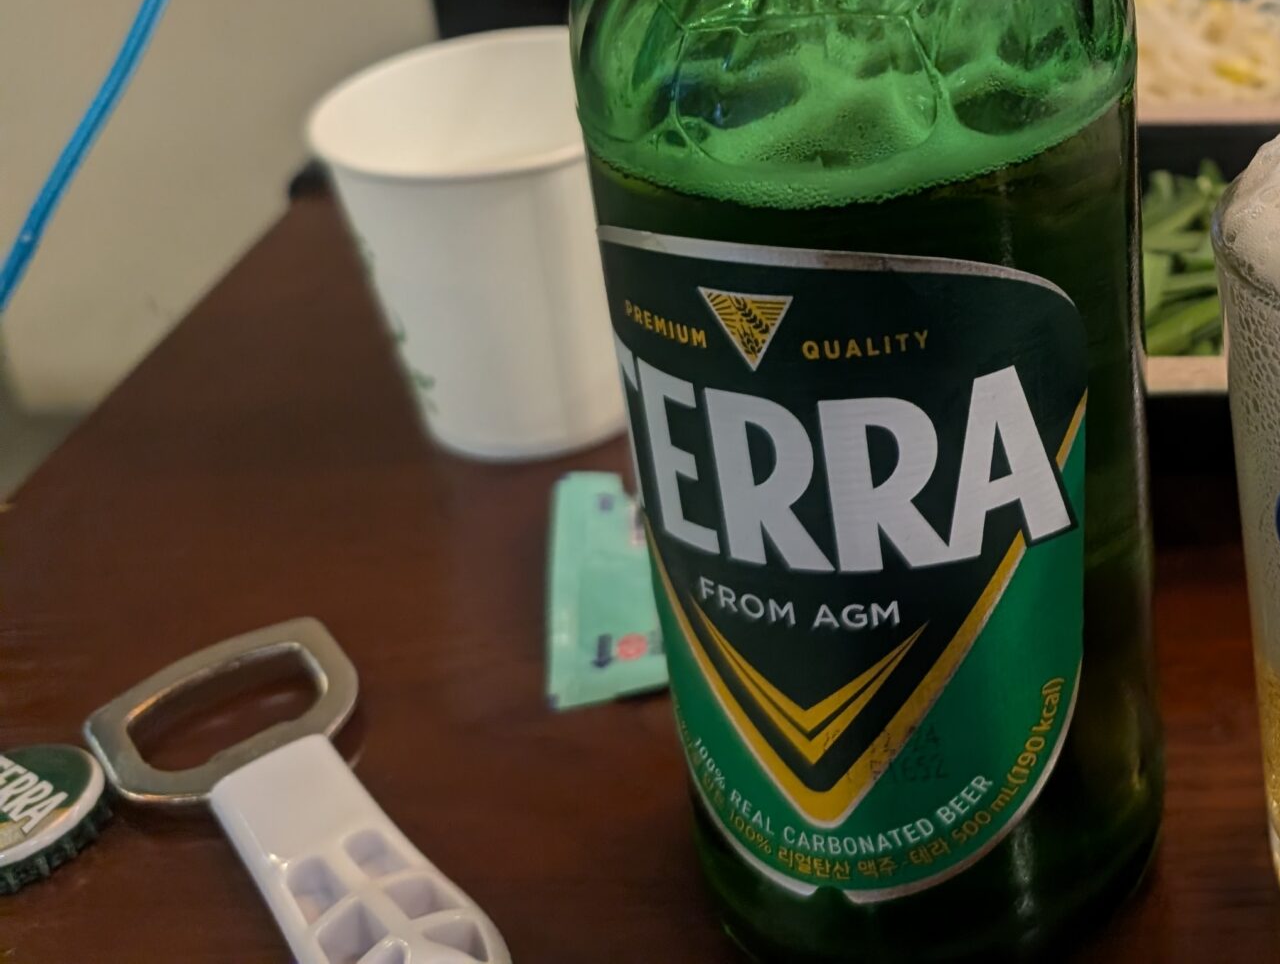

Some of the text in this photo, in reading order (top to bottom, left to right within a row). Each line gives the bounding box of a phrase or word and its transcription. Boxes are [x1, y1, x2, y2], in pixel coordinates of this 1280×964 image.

[623, 299, 928, 361] PREMIUM QUALITY
[698, 577, 901, 629] FROM AGM
[0, 755, 69, 834] ERRA
[694, 737, 727, 790] 100%
[729, 788, 776, 836] REAL
[783, 816, 935, 857] CARBONATED
[935, 774, 994, 825] BEER
[728, 810, 773, 855] 100%
[777, 847, 851, 880] 리얼탄산
[857, 854, 899, 878] 맥주
[908, 836, 951, 866] 테라
[951, 809, 993, 843] 500
